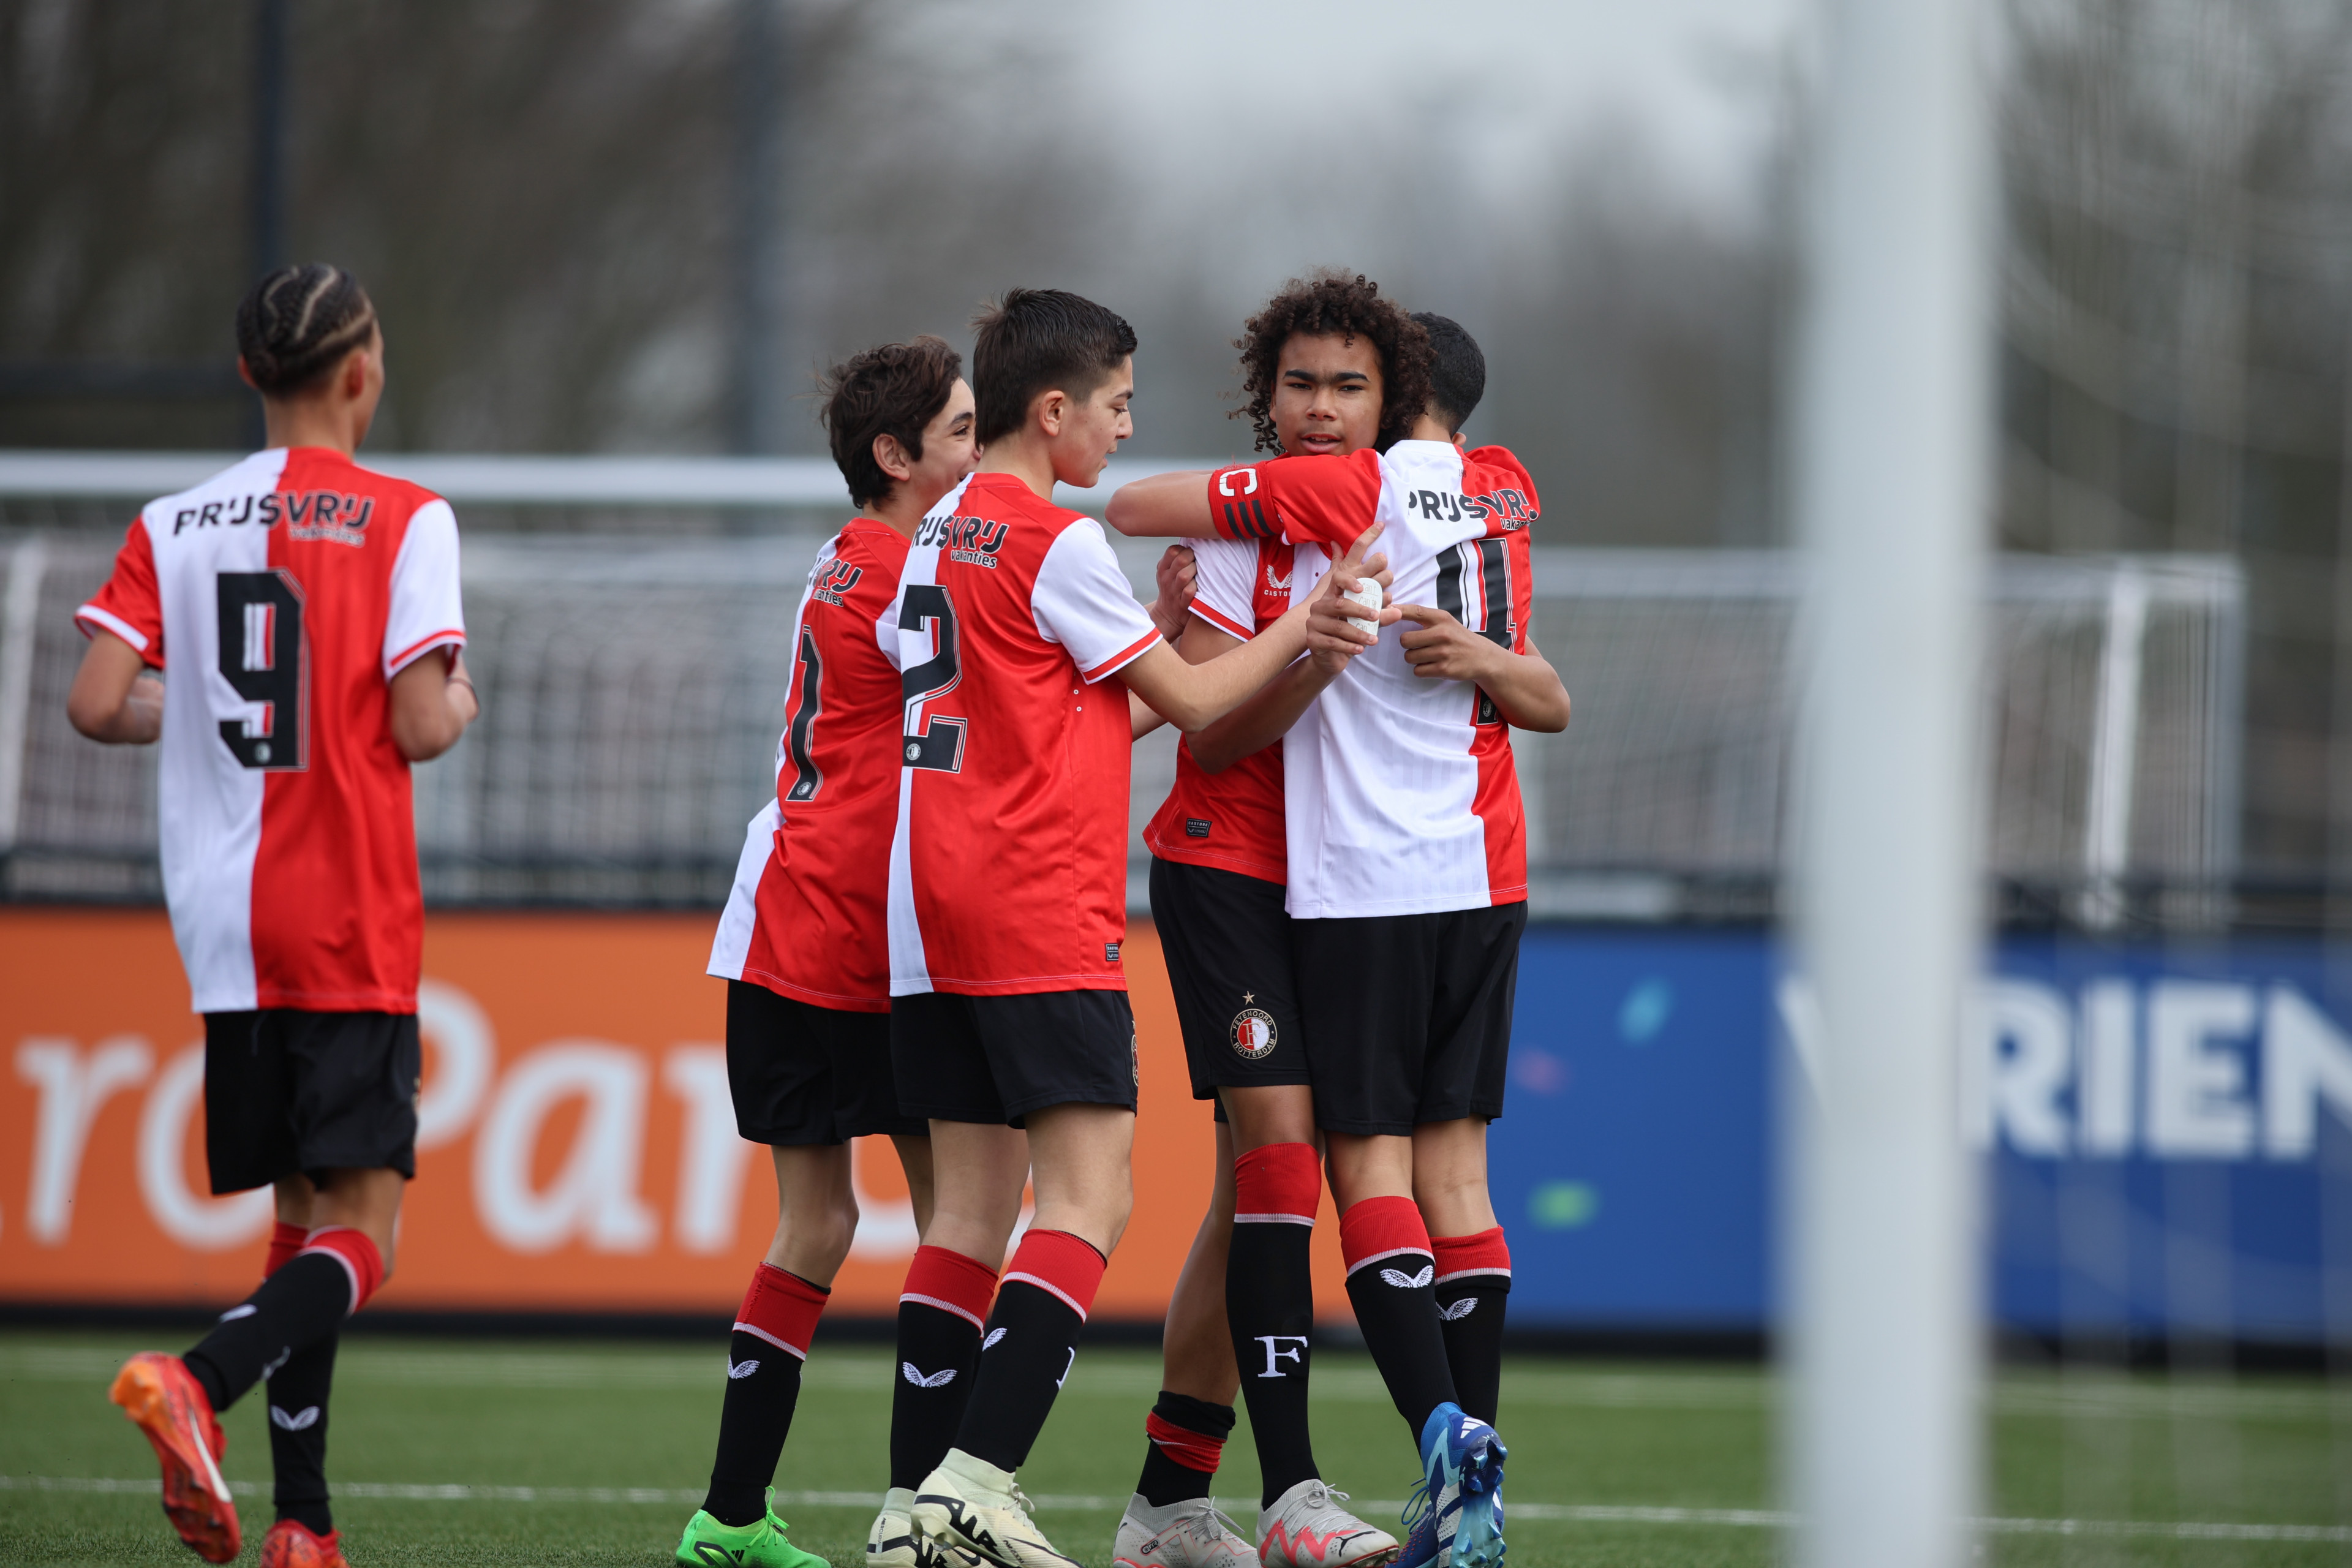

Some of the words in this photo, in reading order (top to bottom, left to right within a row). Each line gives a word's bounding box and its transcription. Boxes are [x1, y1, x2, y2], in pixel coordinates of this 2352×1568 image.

[1219, 468, 1257, 497] C
[911, 514, 1009, 554] RIJSVRIJ
[950, 549, 998, 569] vakanties
[216, 568, 310, 772] 9
[898, 584, 968, 774] 2
[1232, 1011, 1273, 1030] FEYENOORD
[1242, 1022, 1262, 1046] F
[1234, 1038, 1275, 1057] ROTTERDAM
[1254, 1335, 1308, 1378] F
